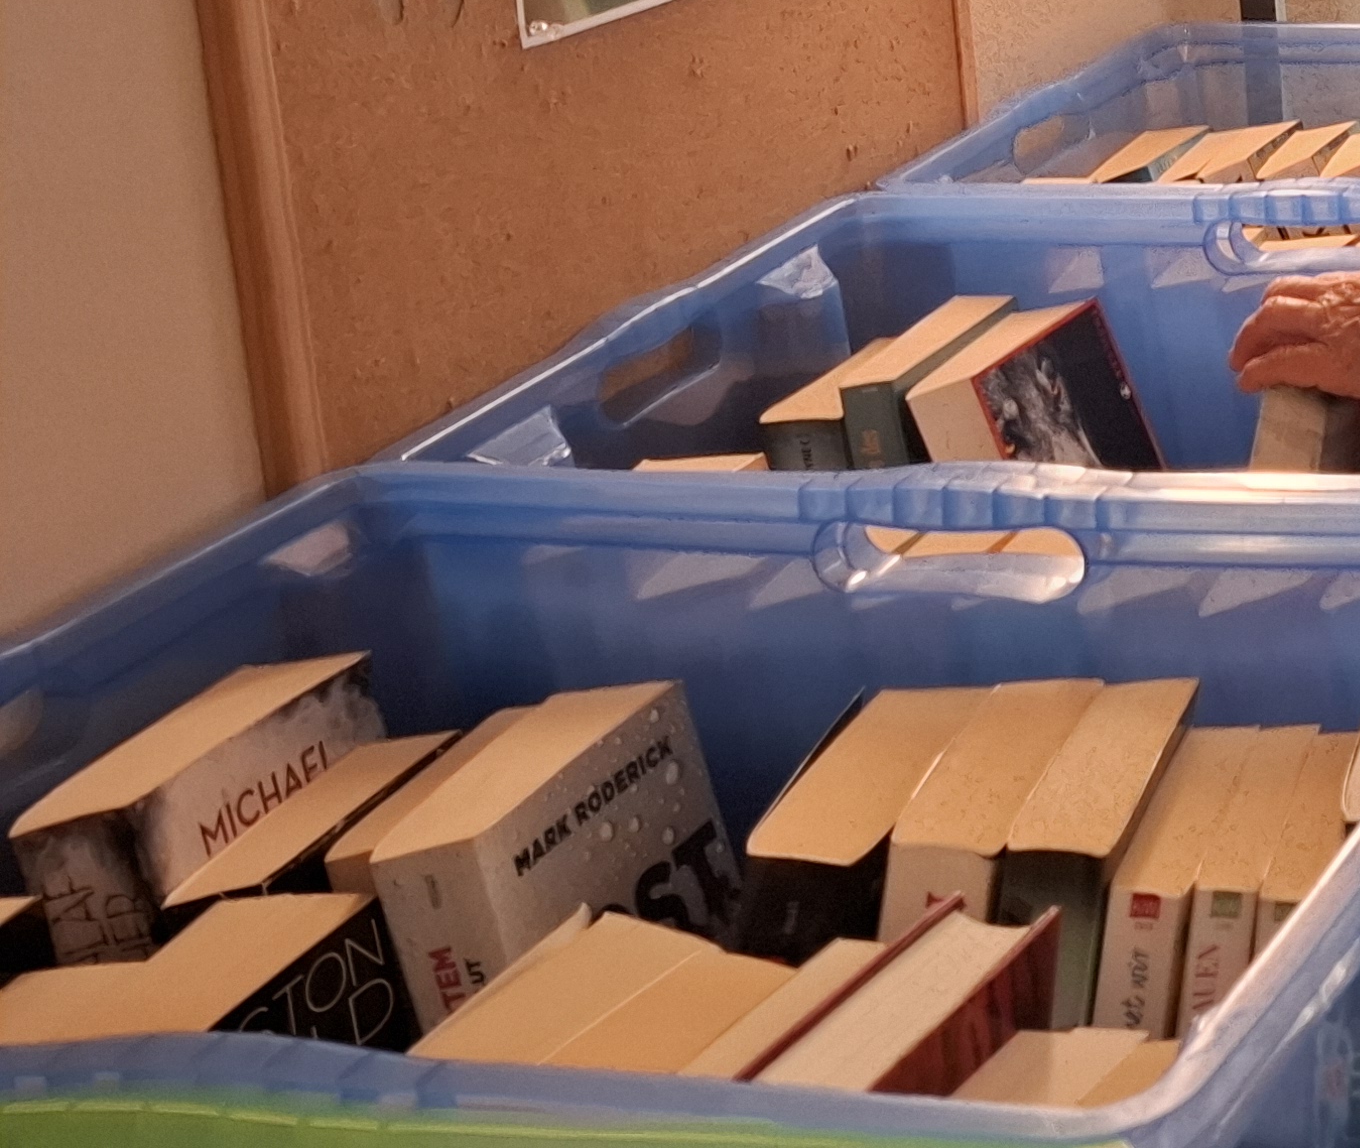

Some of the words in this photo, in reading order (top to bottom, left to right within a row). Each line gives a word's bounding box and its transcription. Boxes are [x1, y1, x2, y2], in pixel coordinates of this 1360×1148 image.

[512, 814, 574, 879] MARK
[572, 734, 675, 830] RODERICK
[602, 819, 744, 932] ST
[427, 945, 468, 1015] TEM
